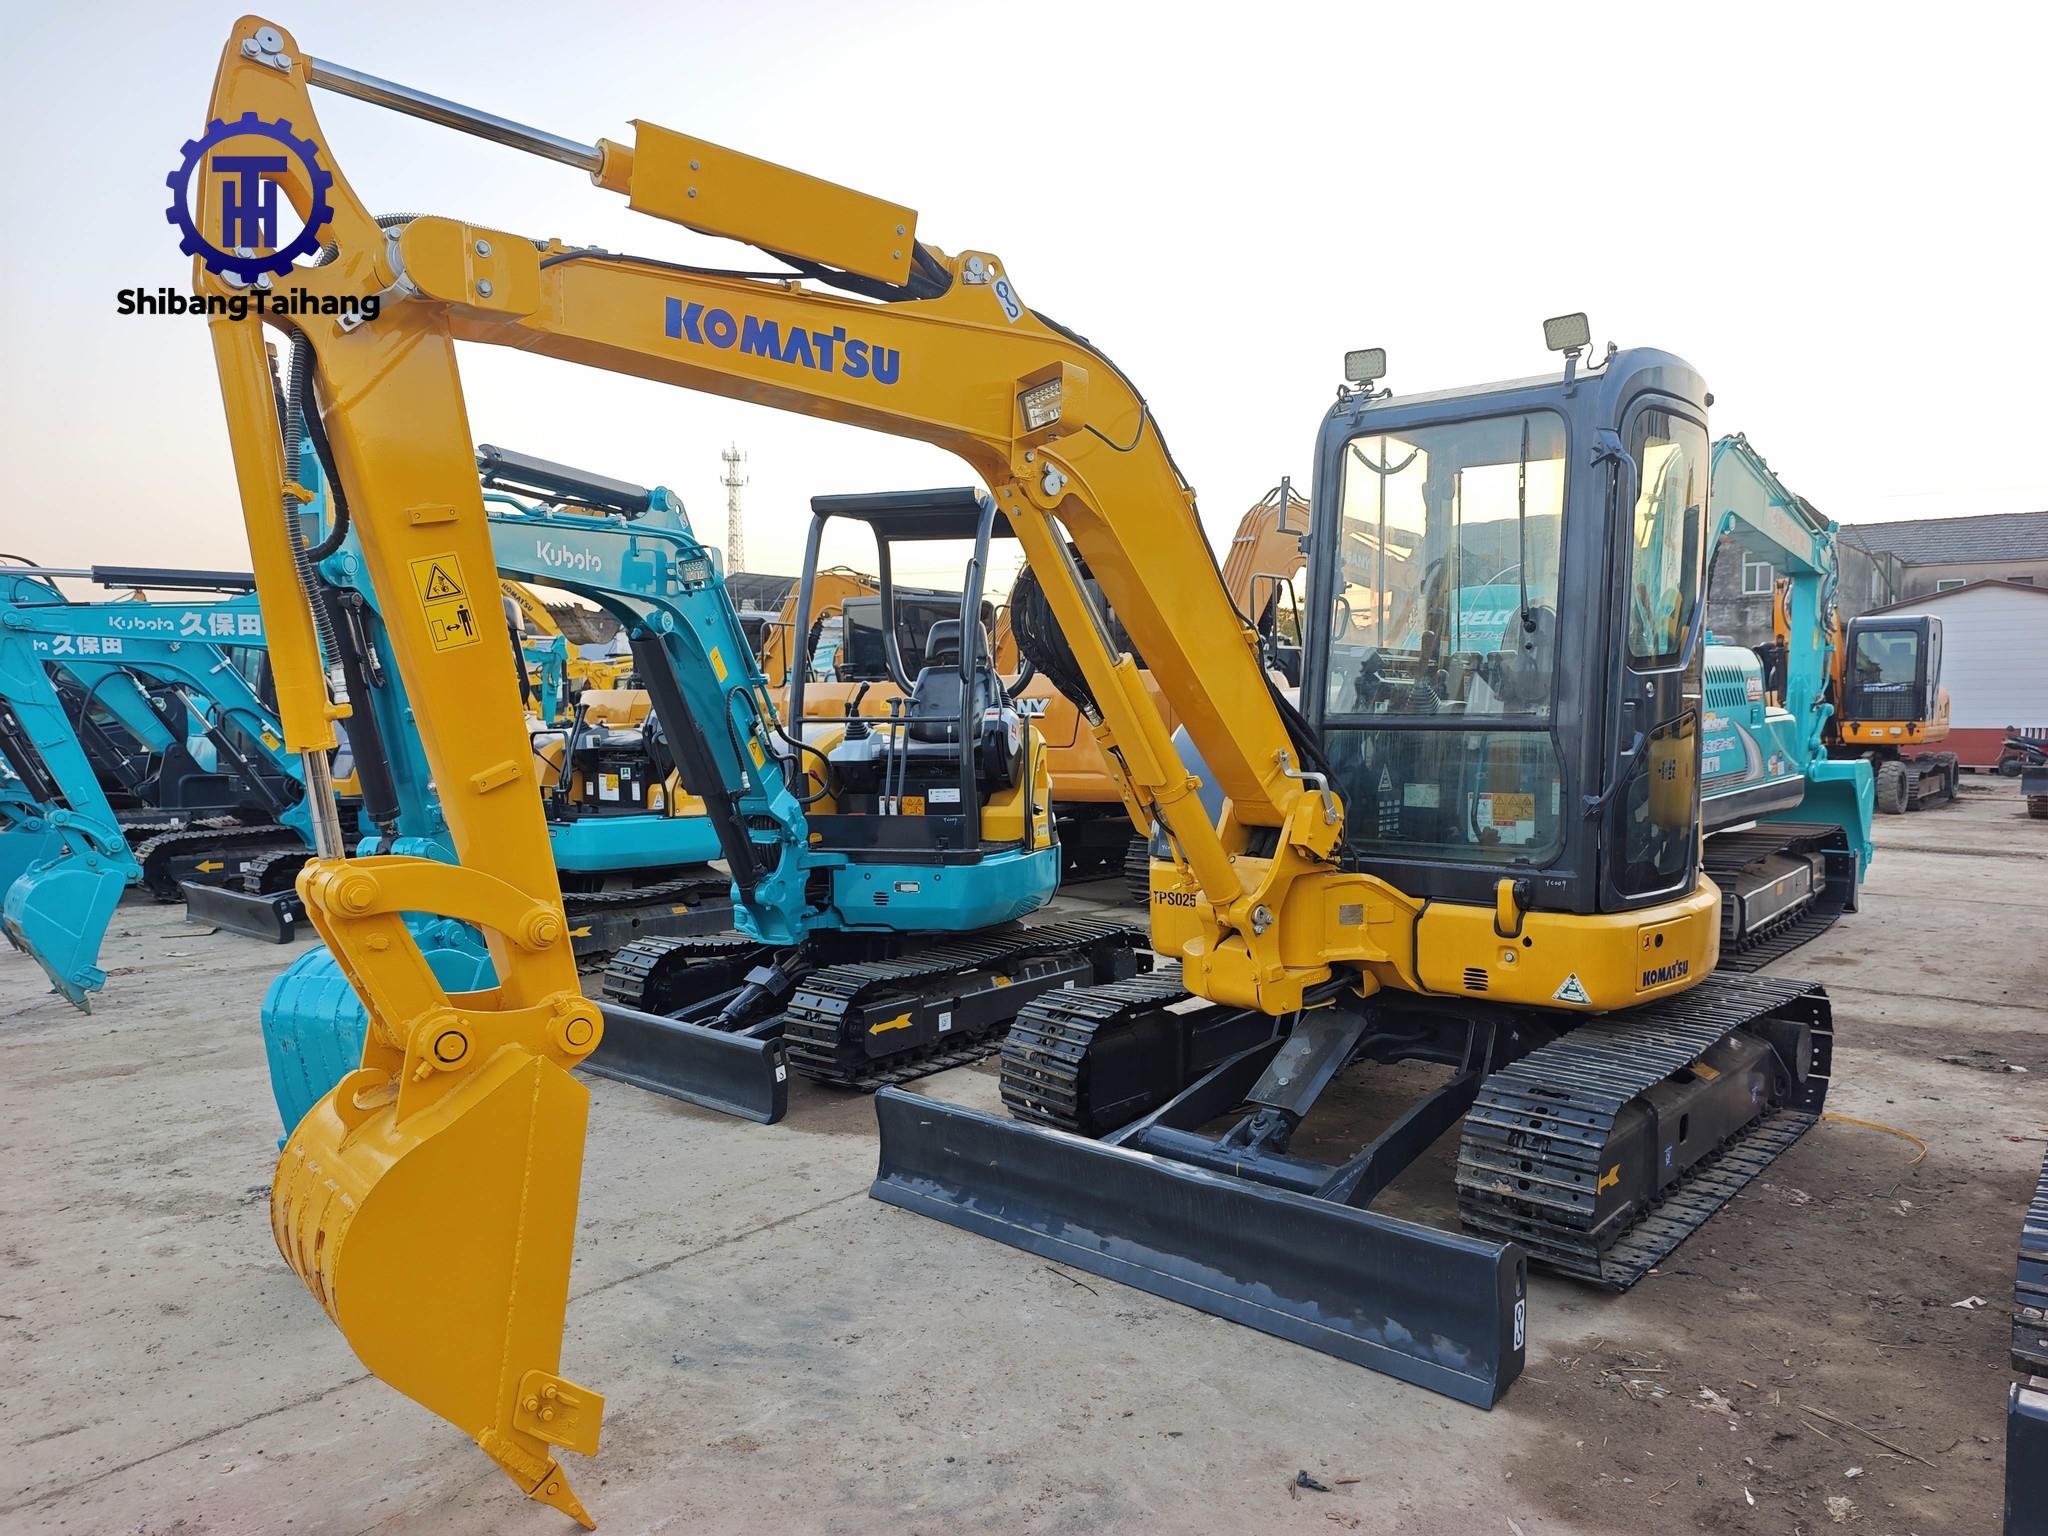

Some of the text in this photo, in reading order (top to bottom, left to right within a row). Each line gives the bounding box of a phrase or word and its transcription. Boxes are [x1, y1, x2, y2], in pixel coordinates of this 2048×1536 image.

[665, 296, 900, 385] KOMATSU
[536, 540, 602, 573] Kubota
[501, 582, 534, 612] KOMATSU
[109, 611, 262, 637] Kubota 久保田
[52, 635, 123, 655] 久保田
[1153, 890, 1197, 908] TPS025
[1642, 960, 1689, 987] KOMATSU
